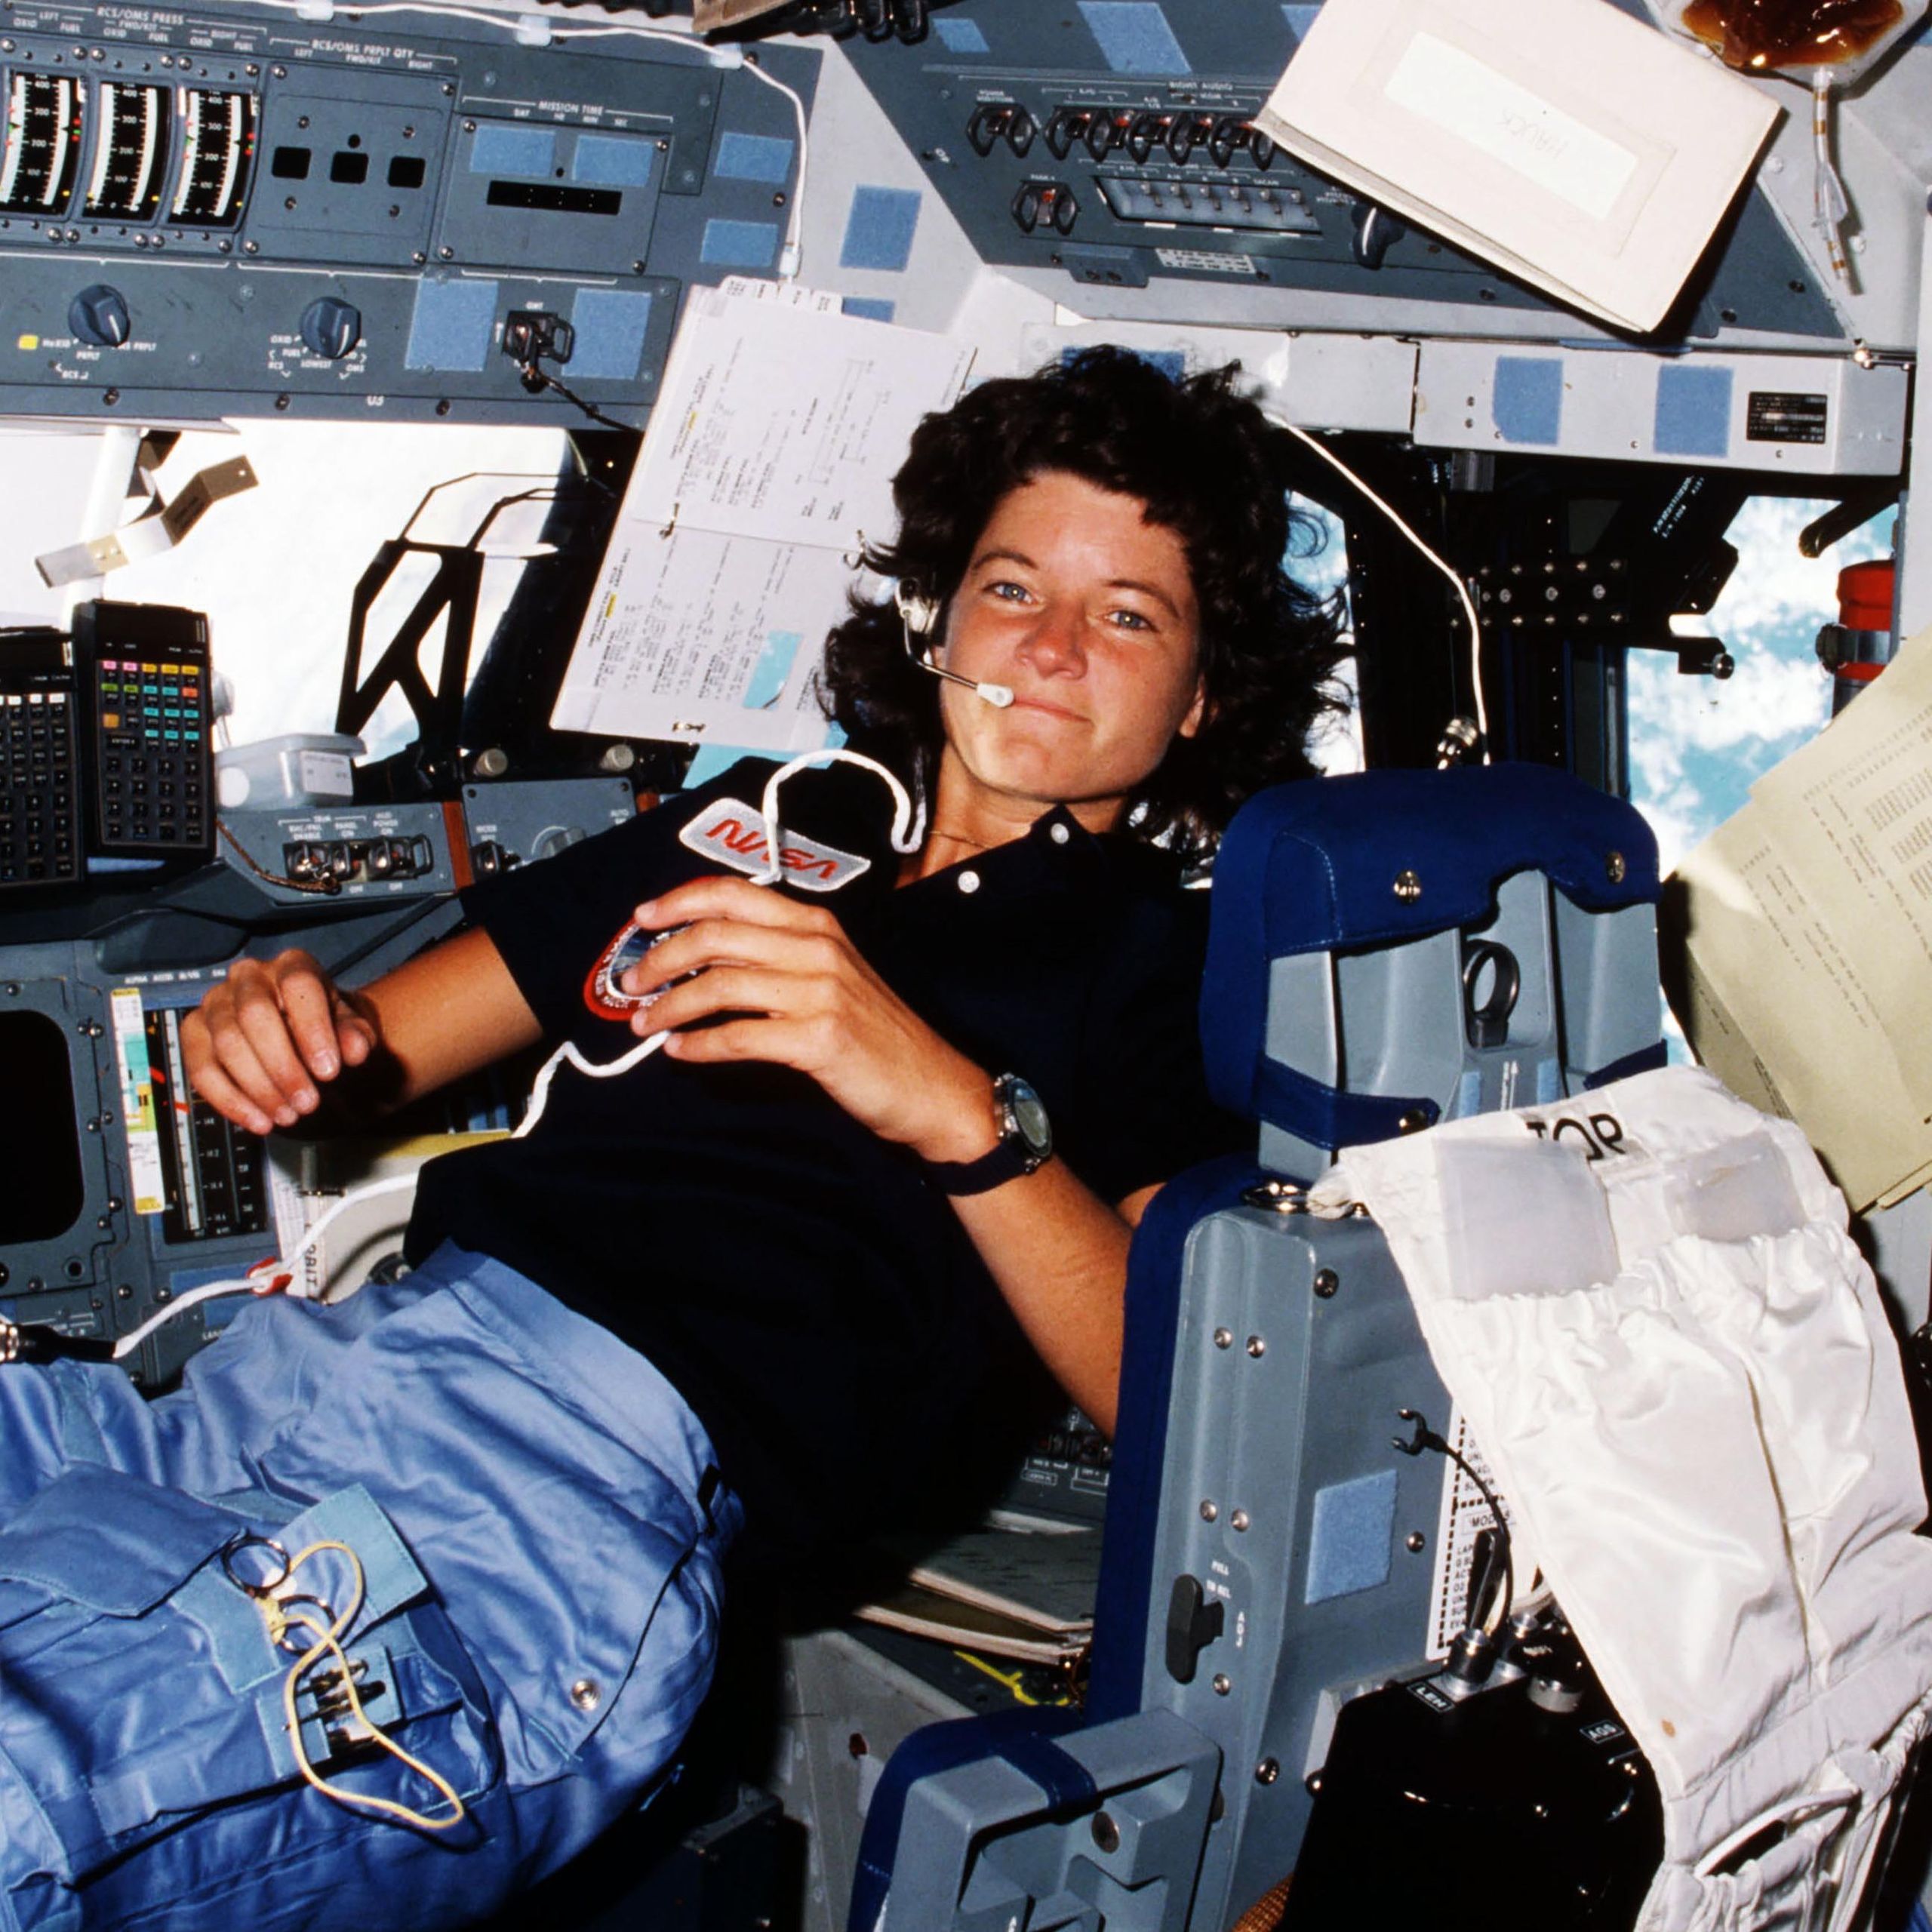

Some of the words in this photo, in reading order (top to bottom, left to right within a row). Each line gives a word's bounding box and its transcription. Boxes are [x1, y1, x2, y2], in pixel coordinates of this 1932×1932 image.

[39, 11, 59, 21] LEFT
[97, 6, 149, 21] RCS/OMS
[152, 12, 183, 25] PRESS
[60, 23, 81, 33] FUEL
[149, 33, 169, 43] FUEL
[233, 42, 254, 51] FUEL
[312, 39, 360, 54] RCS/OMS
[364, 45, 390, 57] PRPLT
[393, 48, 414, 59] QTY
[294, 48, 313, 57] LEFT
[539, 100, 578, 113] MISSION
[582, 105, 603, 115] TIME
[373, 820, 398, 829] POWER
[341, 830, 355, 838] ON
[380, 827, 393, 835] ON
[705, 819, 838, 880] NASA
[1526, 1113, 1626, 1162] TOP
[1472, 1509, 1509, 1527] MODS
[1235, 1611, 1245, 1647] ADJ
